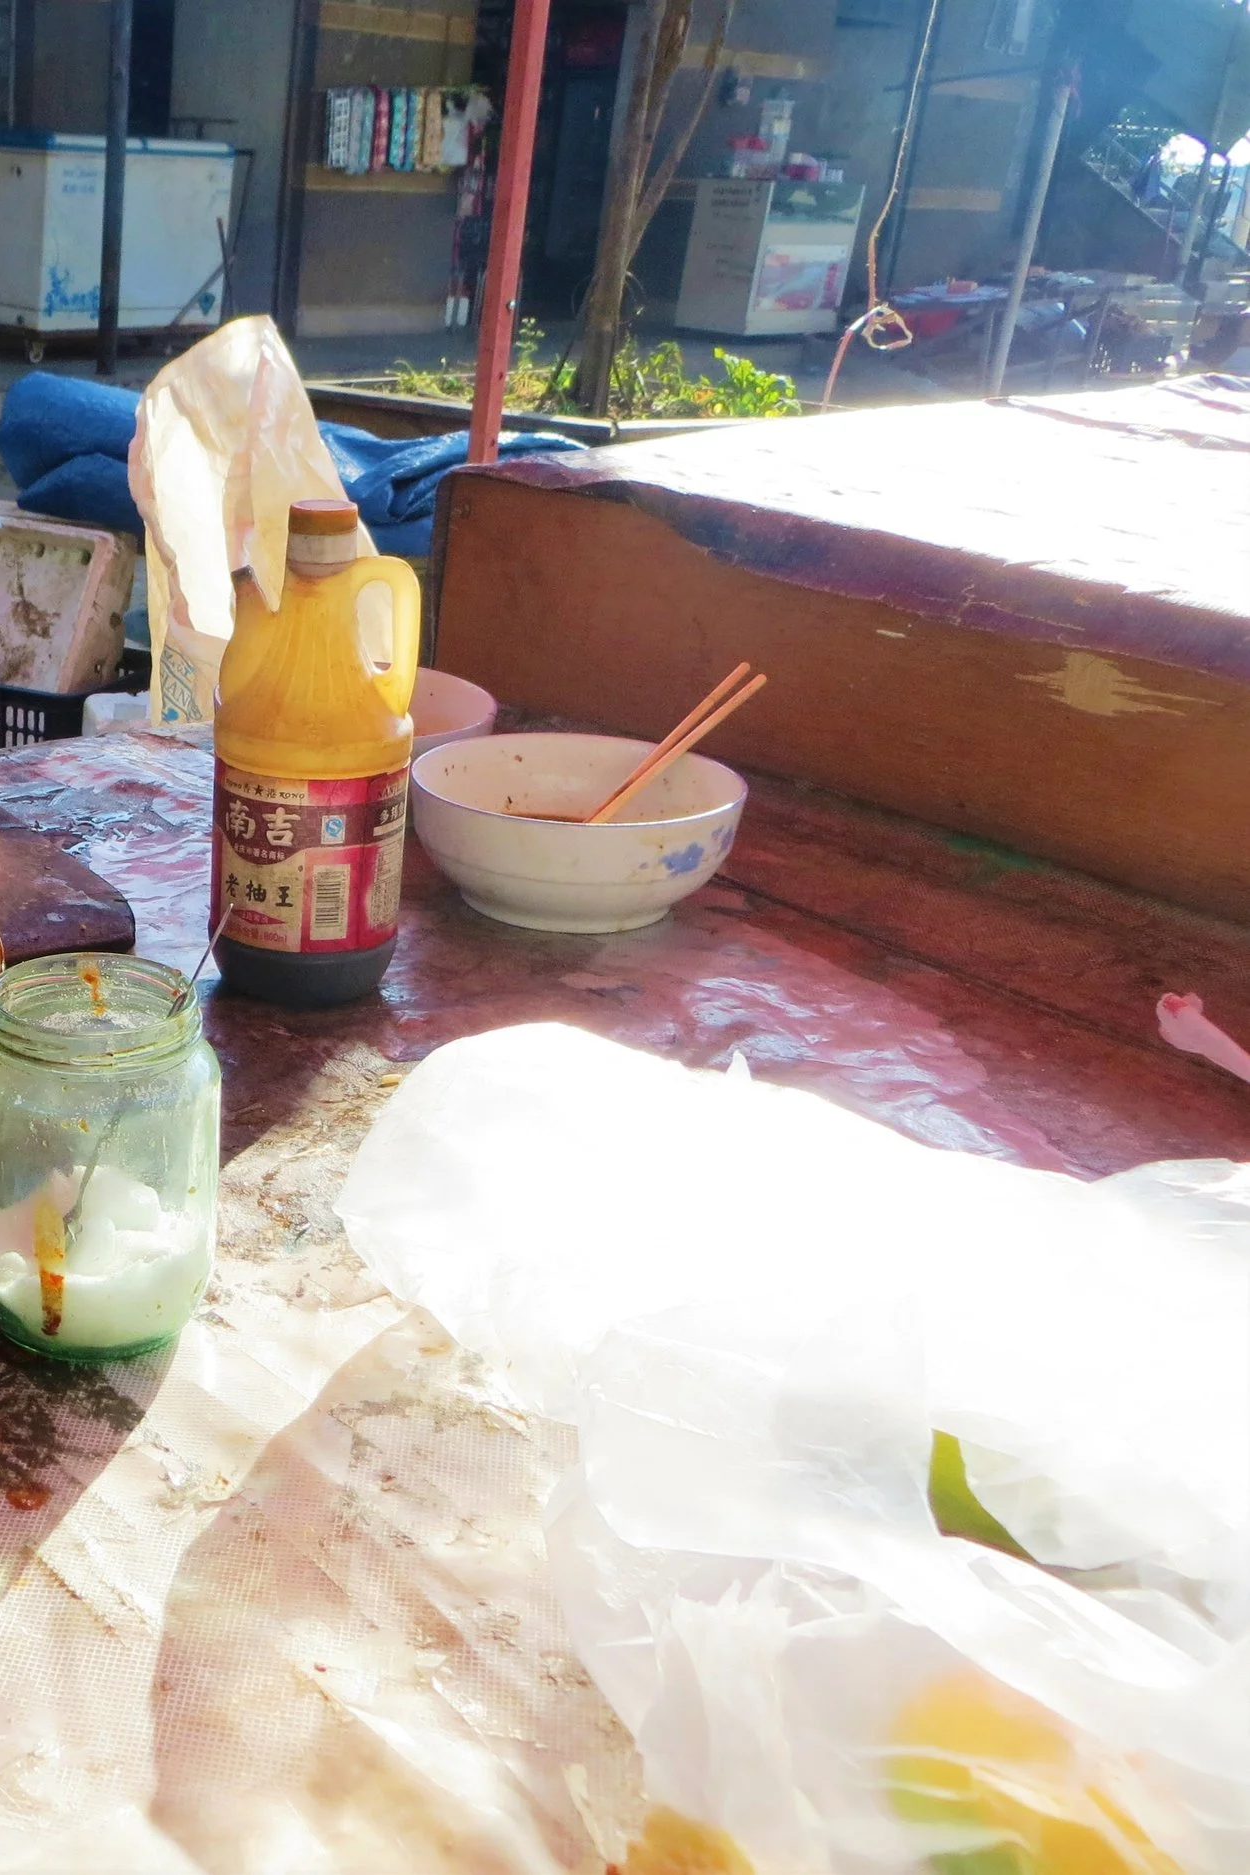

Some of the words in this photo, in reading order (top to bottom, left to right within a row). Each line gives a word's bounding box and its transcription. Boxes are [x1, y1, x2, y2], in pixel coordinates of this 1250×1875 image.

[225, 799, 301, 847] 南吉
[225, 872, 294, 908] 老抽王
